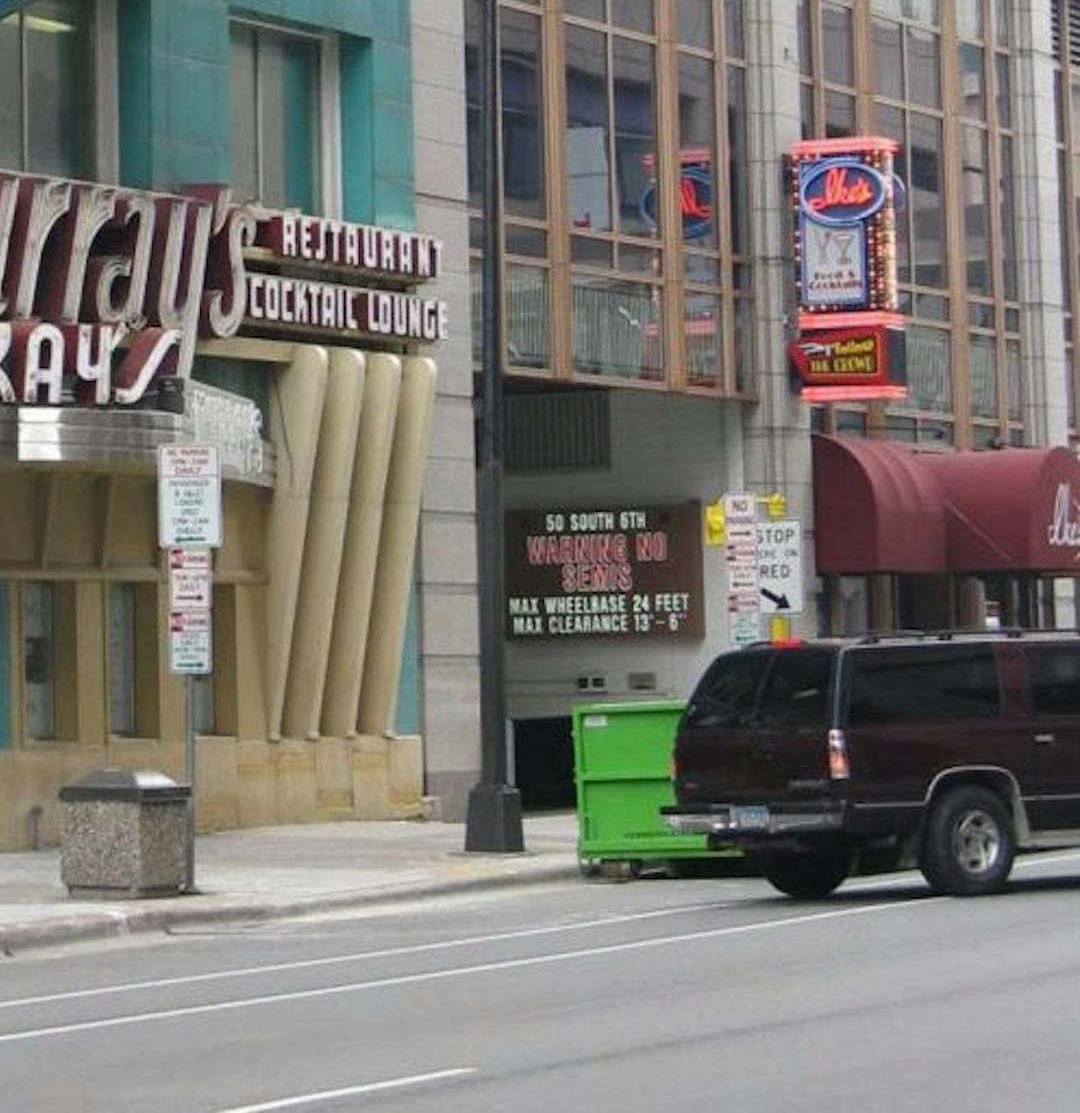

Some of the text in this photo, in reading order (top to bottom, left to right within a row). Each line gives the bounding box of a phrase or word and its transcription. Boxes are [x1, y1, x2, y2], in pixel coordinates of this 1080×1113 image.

[283, 217, 443, 279] RESTAURANT
[248, 276, 452, 340] COCKTAIL LOUNGE
[545, 511, 647, 532] 50 SOUTH 6TH
[526, 531, 668, 565] WARNING NO
[759, 563, 792, 579] RED
[509, 593, 690, 615] MAX WHEELBASE 24 FEET
[513, 617, 543, 635] MAX
[547, 614, 628, 634] CLEARANCE
